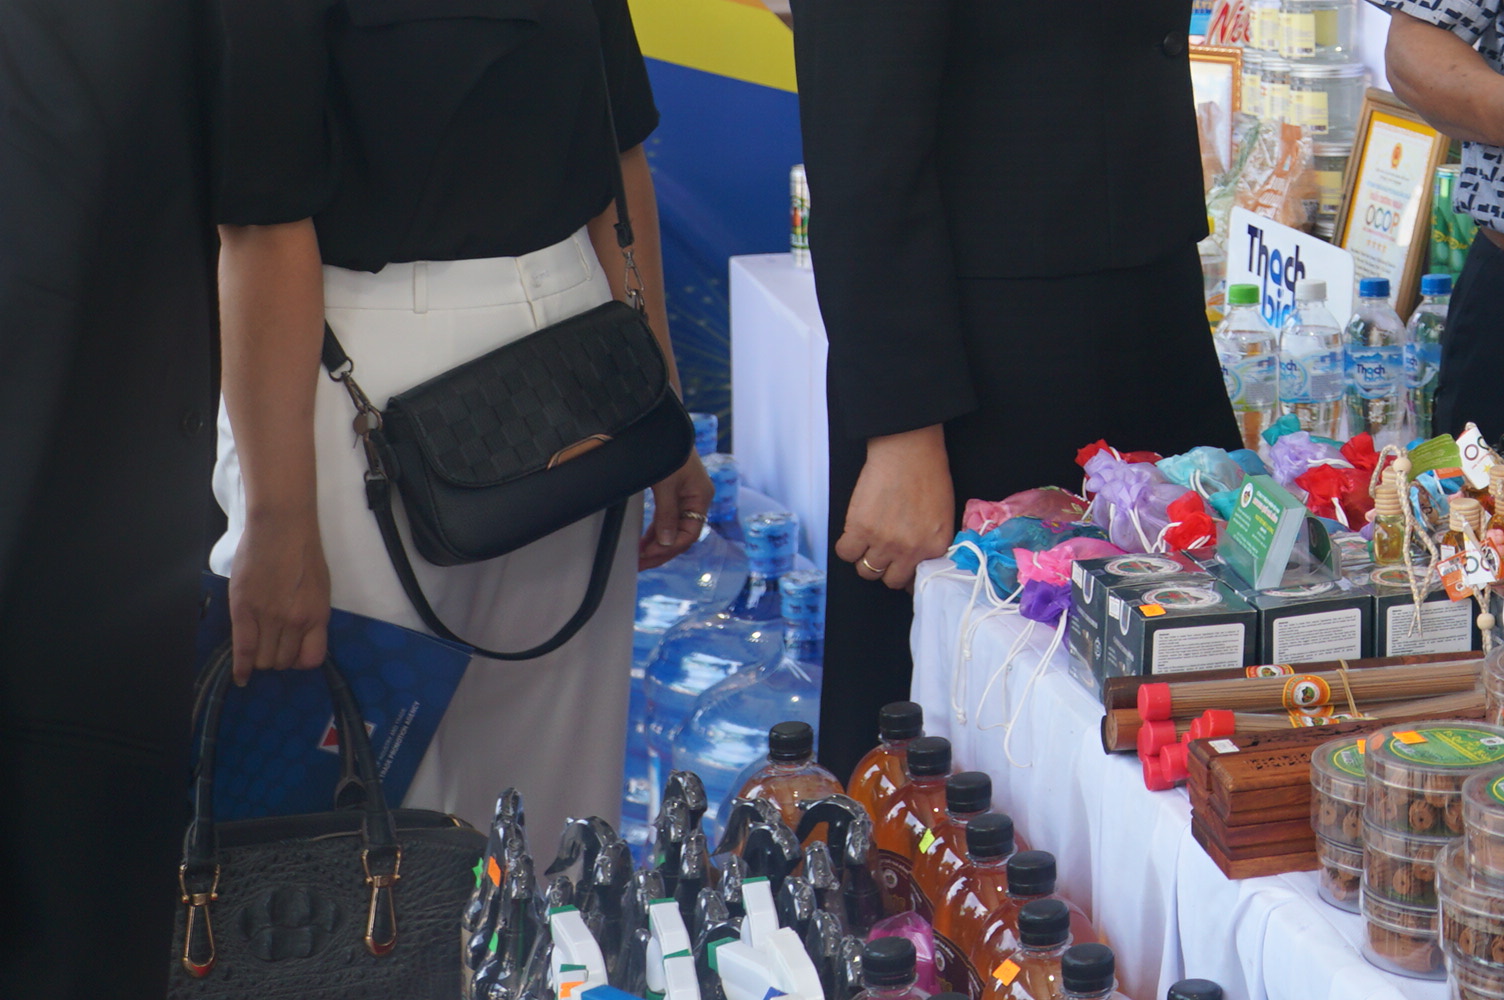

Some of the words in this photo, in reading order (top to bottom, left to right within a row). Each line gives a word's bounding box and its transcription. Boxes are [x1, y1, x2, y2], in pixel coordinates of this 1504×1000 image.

[1366, 204, 1401, 235] OCOP
[388, 725, 409, 760] PROMOTION
[404, 700, 420, 727] AGENCY
